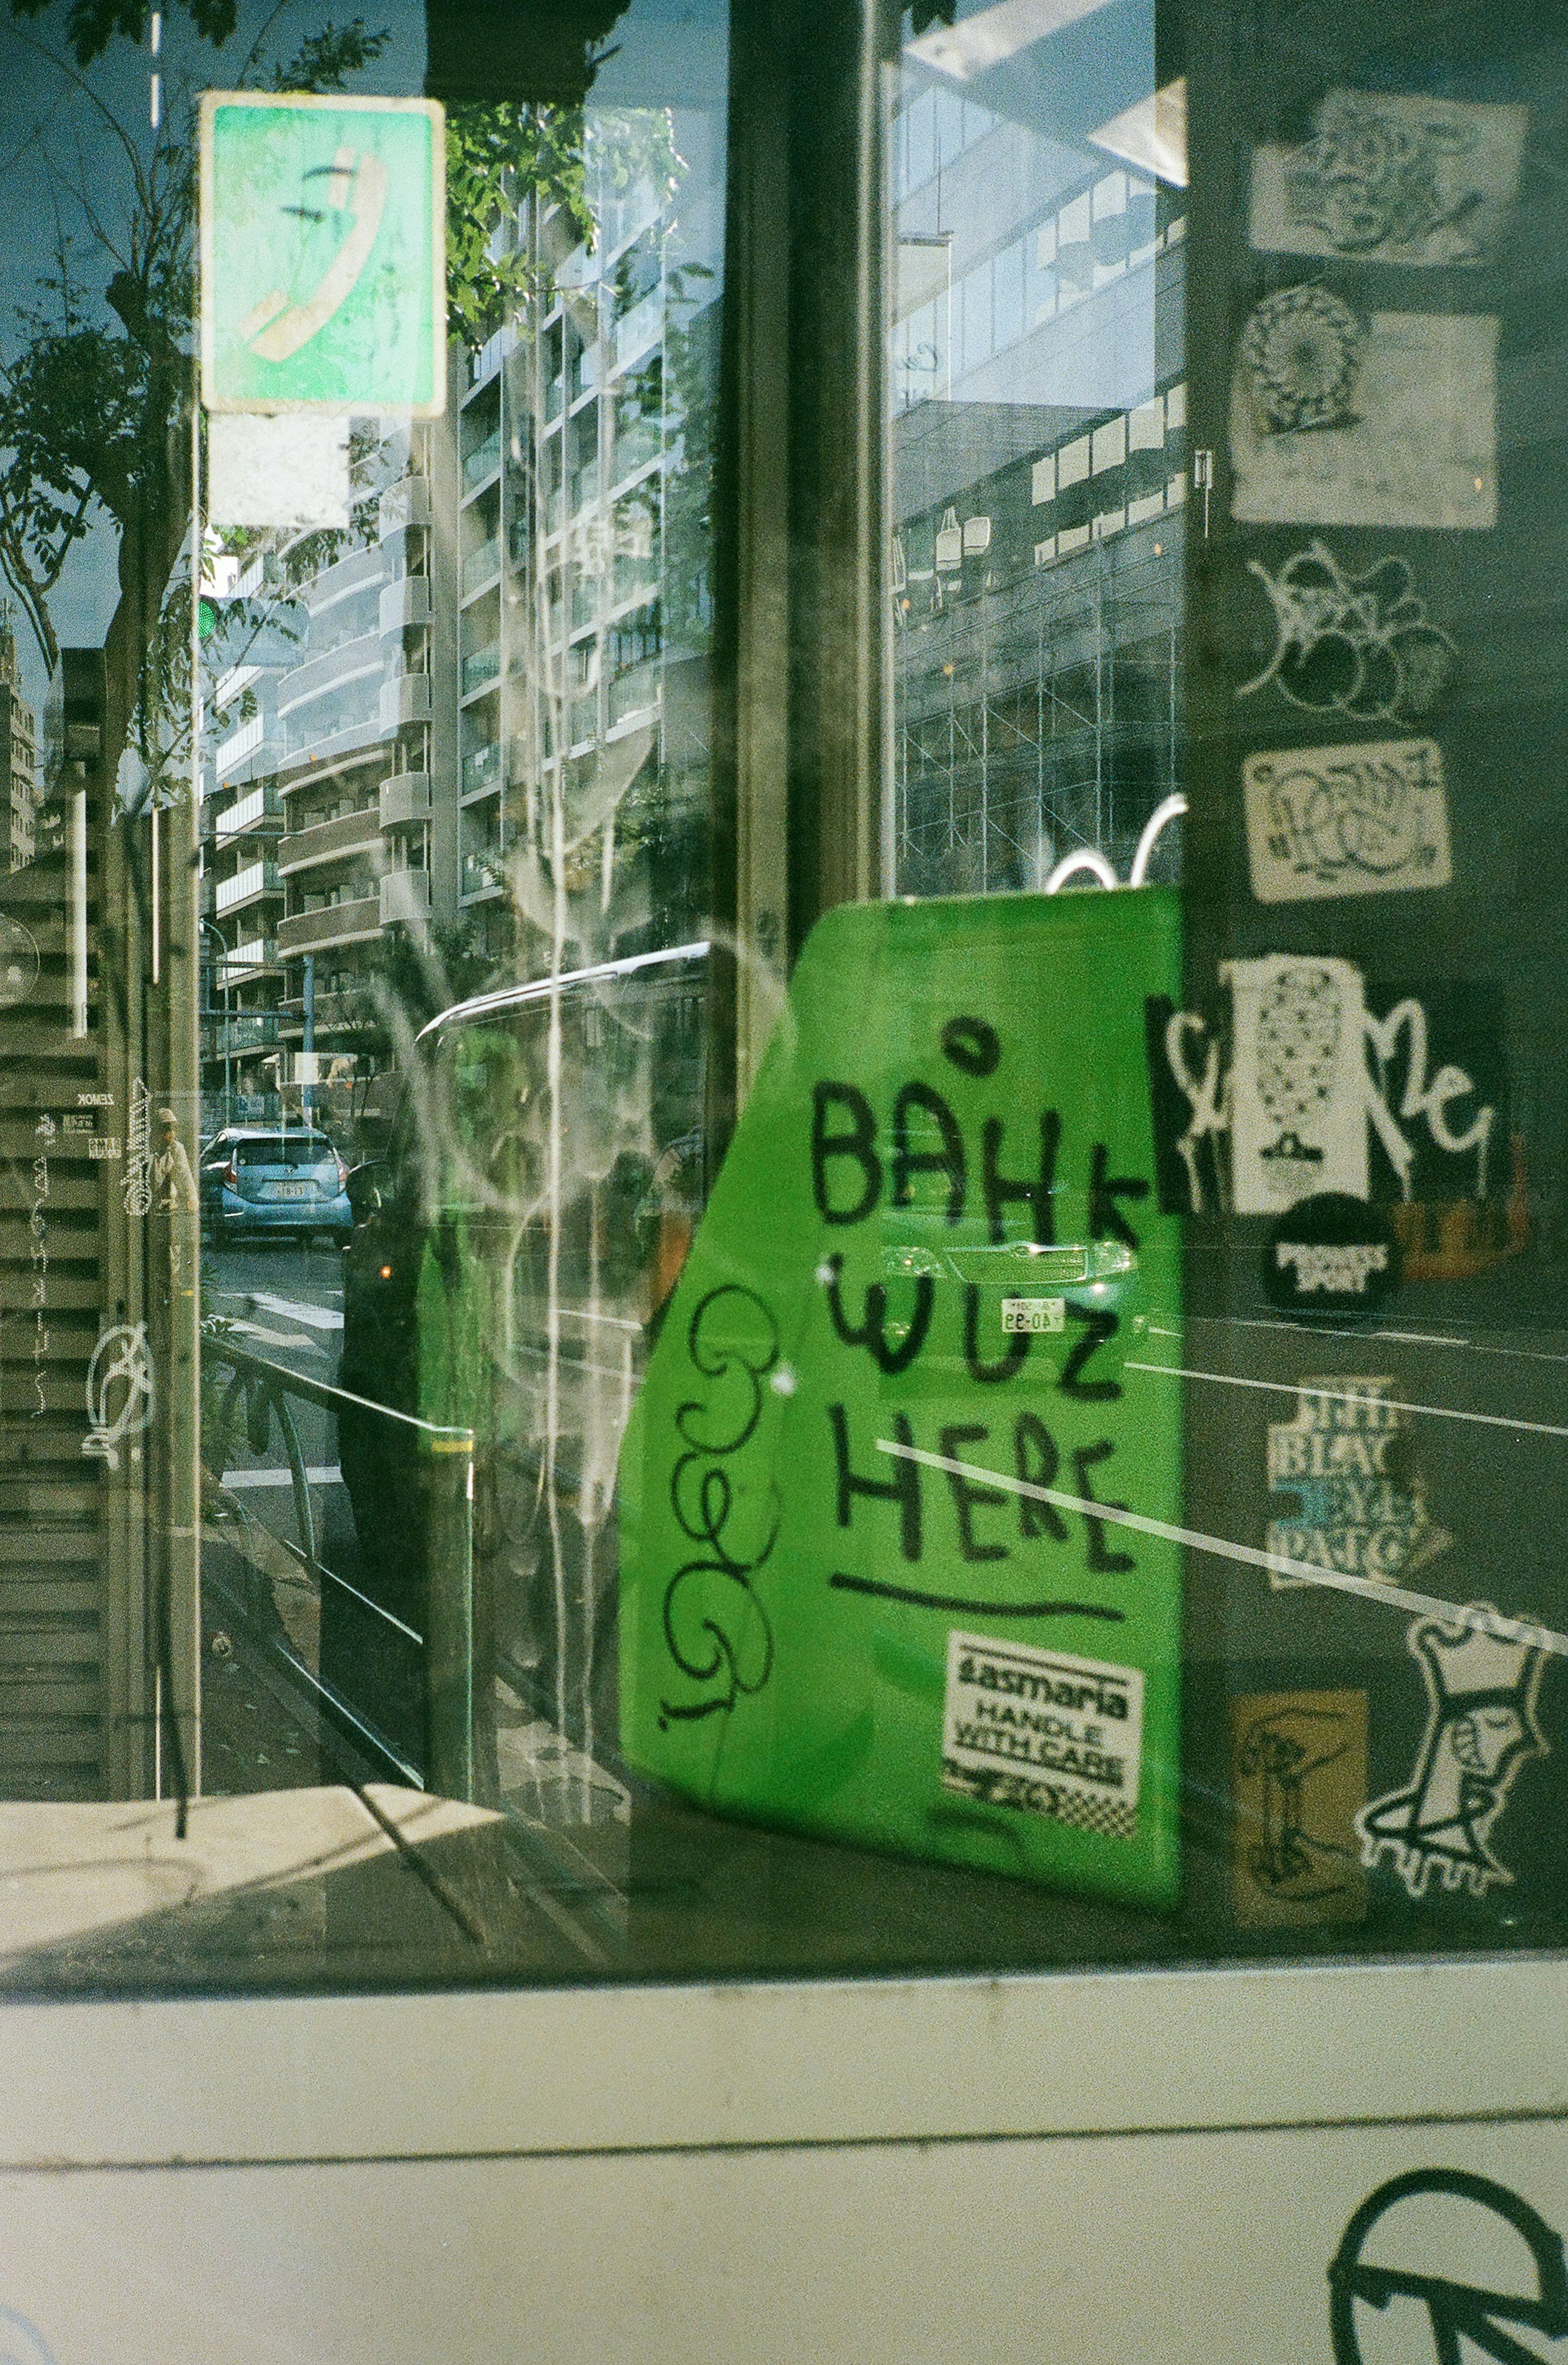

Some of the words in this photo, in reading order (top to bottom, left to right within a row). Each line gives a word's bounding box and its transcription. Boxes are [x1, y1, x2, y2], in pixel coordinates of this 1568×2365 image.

[827, 1254, 1122, 1401] WUZ
[828, 1403, 1135, 1572] HERE
[955, 1720, 1031, 1759] WITH
[1038, 1740, 1124, 1779] CARE
[977, 1699, 1104, 1748] HANDLE
